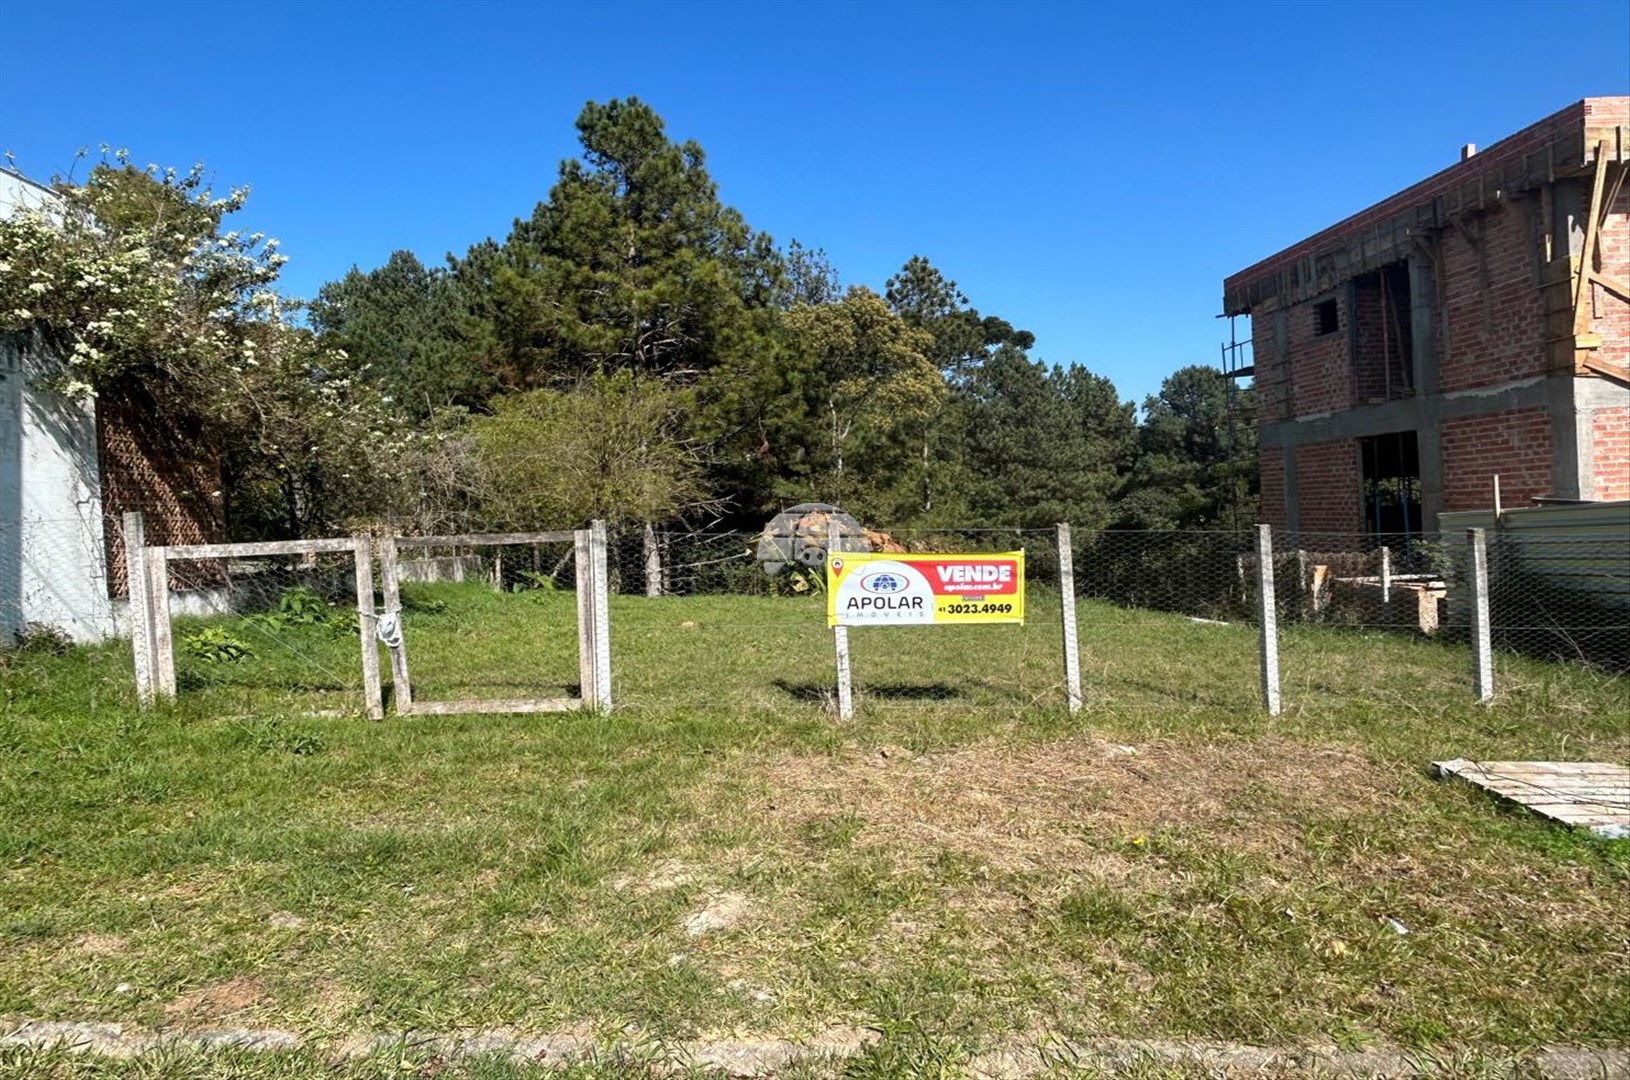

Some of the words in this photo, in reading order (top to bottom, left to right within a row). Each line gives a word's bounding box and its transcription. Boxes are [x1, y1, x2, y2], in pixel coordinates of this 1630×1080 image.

[936, 565, 1011, 582] VENDE
[943, 583, 1003, 592] apolar.com.br
[847, 596, 923, 610] APOLAR
[948, 604, 1012, 614] 3023.4949
